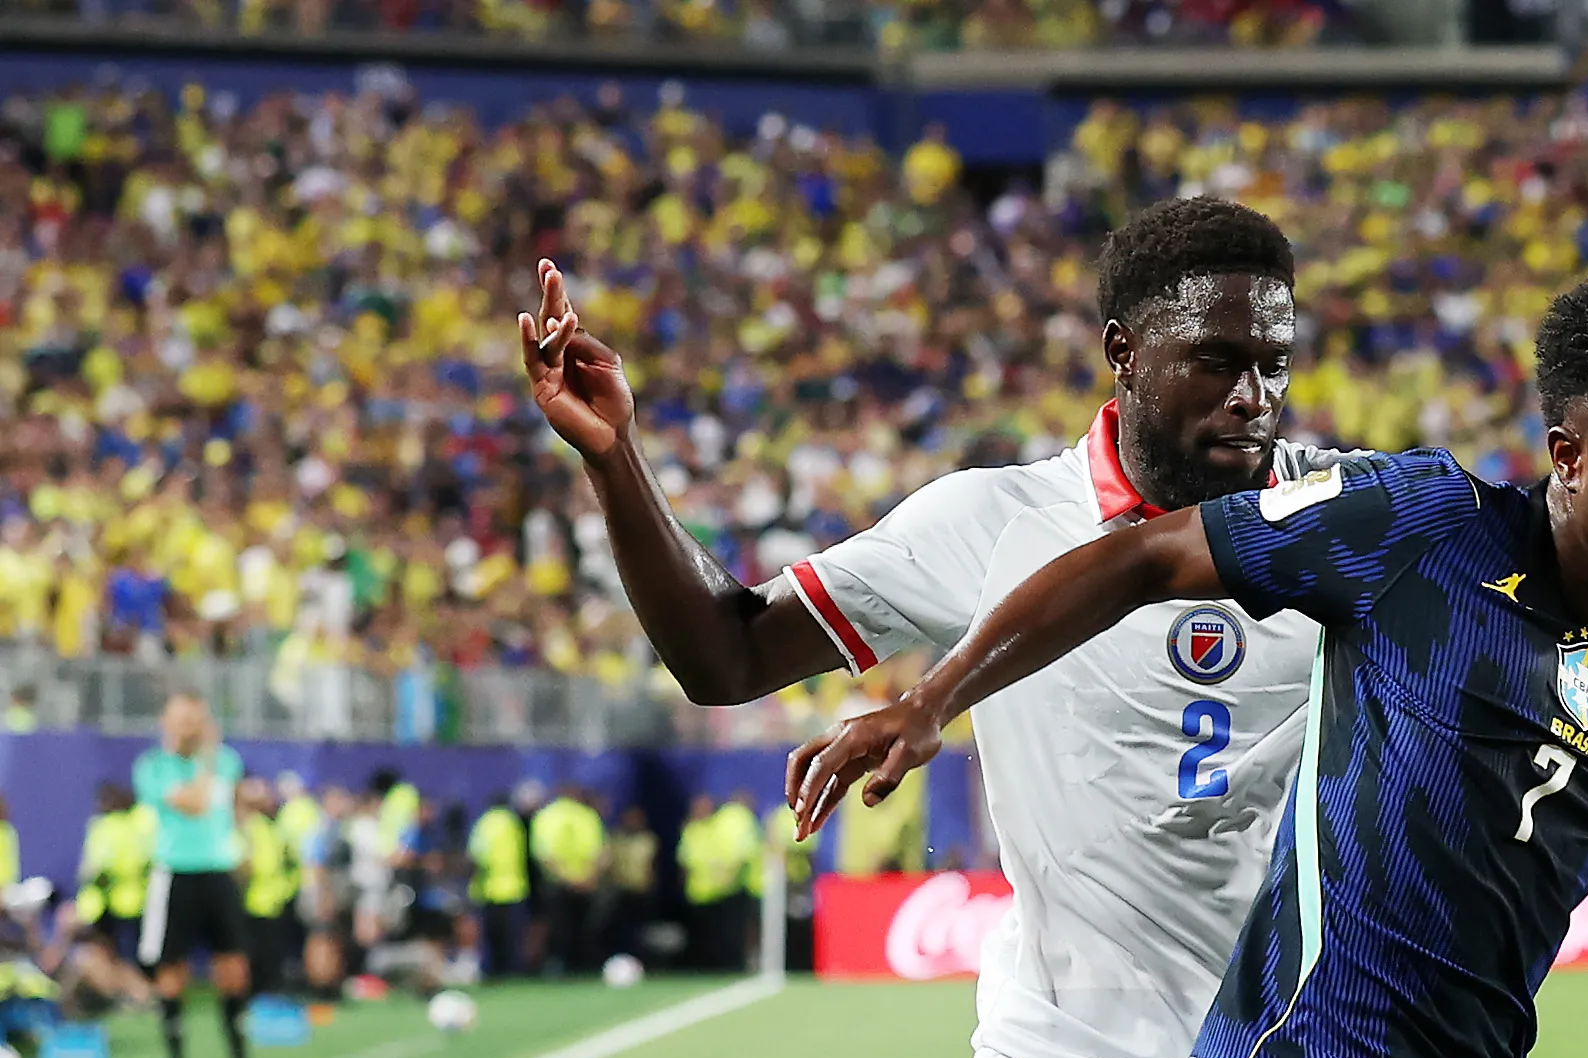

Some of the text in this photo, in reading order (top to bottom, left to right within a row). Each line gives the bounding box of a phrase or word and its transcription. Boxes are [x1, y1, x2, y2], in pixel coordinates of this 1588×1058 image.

[1194, 623, 1222, 631] HAITI
[1178, 700, 1231, 799] 2
[1514, 744, 1577, 843] 7
